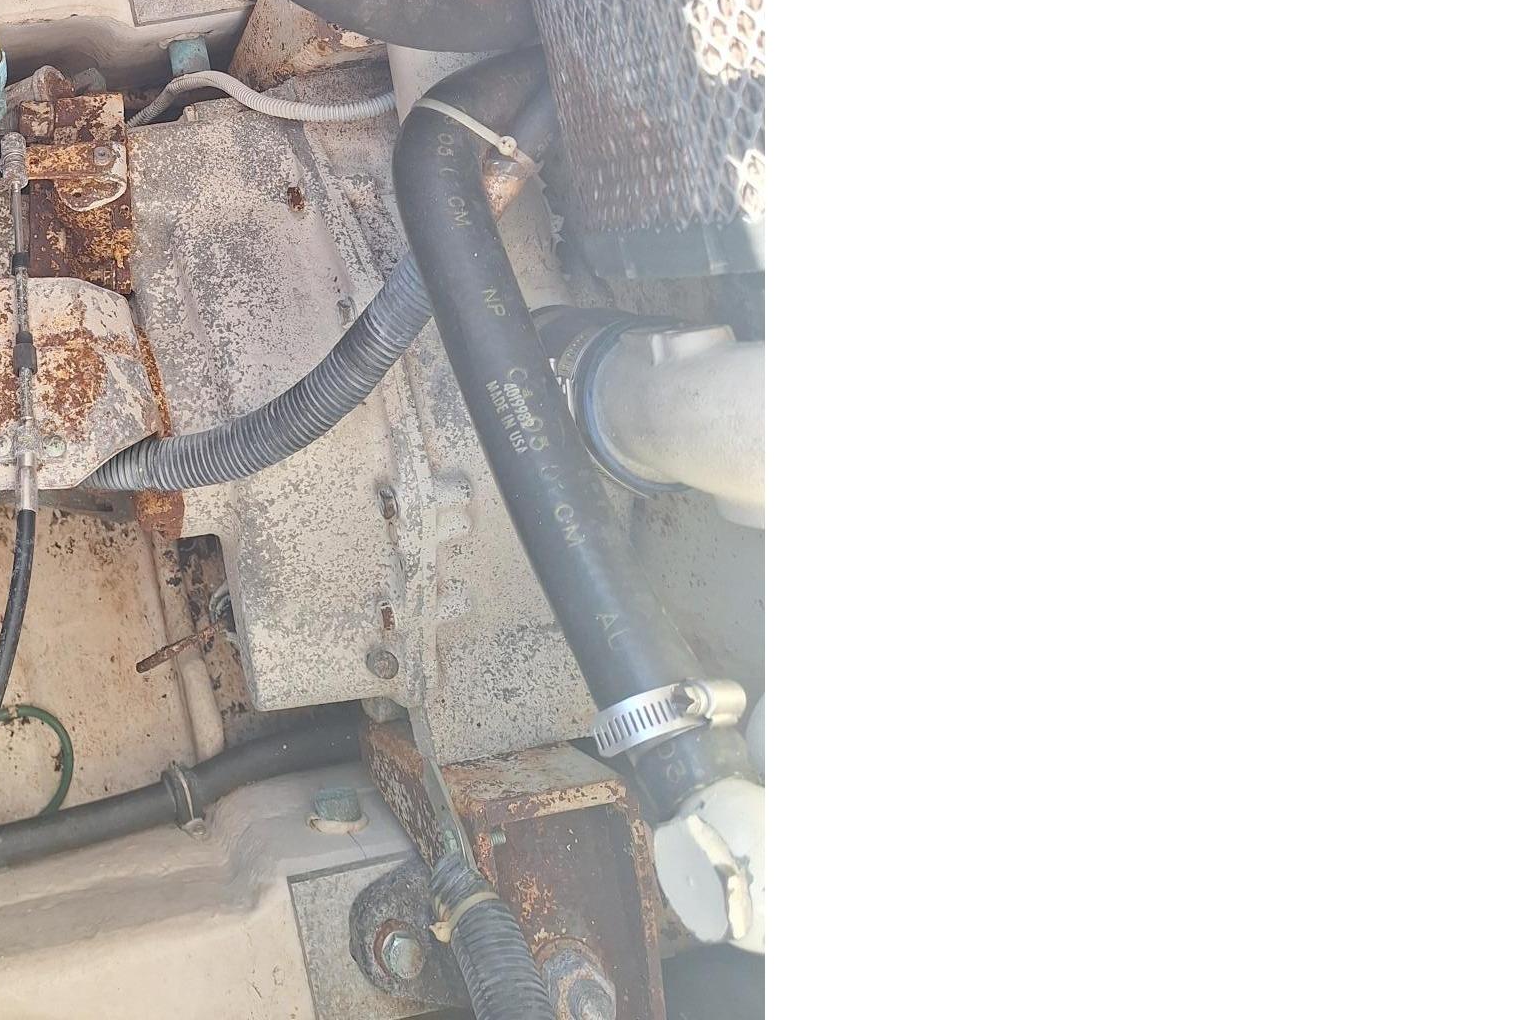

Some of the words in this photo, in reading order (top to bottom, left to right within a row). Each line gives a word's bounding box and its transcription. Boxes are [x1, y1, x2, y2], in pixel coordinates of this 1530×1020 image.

[481, 286, 508, 320] NP
[486, 380, 509, 414] MADE
[501, 413, 517, 430] IN
[509, 430, 528, 453] USA
